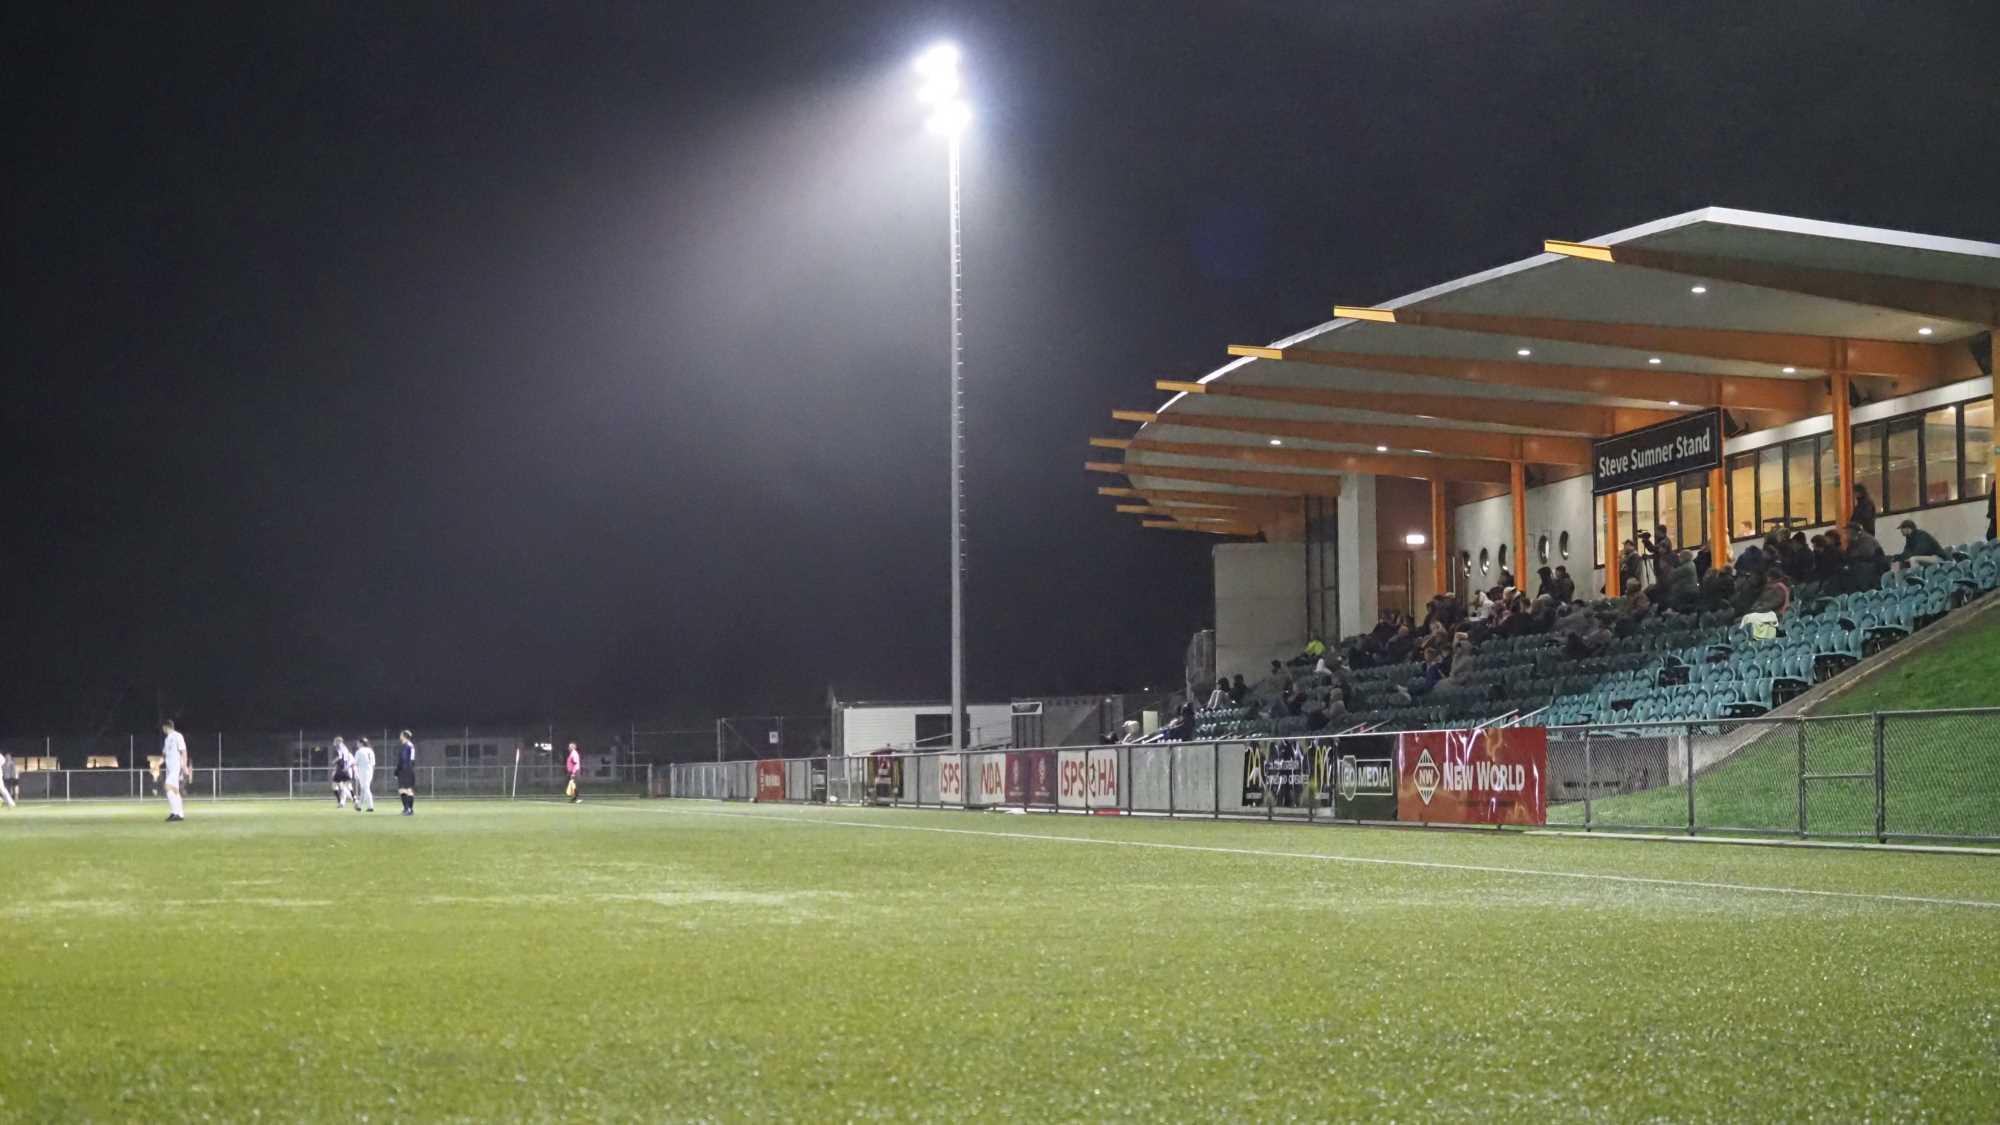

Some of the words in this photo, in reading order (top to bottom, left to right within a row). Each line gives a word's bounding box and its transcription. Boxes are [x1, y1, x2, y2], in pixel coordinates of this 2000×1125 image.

[1599, 455, 1629, 478] Steve
[1630, 443, 1673, 470] Sumner
[1676, 428, 1710, 458] Stand
[941, 762, 960, 794] ISPS
[1061, 760, 1085, 797] ISPS
[1098, 758, 1115, 796] HA
[1358, 766, 1389, 787] MEDIA
[1418, 769, 1434, 785] NW
[1443, 762, 1474, 791] NEW
[1476, 761, 1526, 791] WORLD
